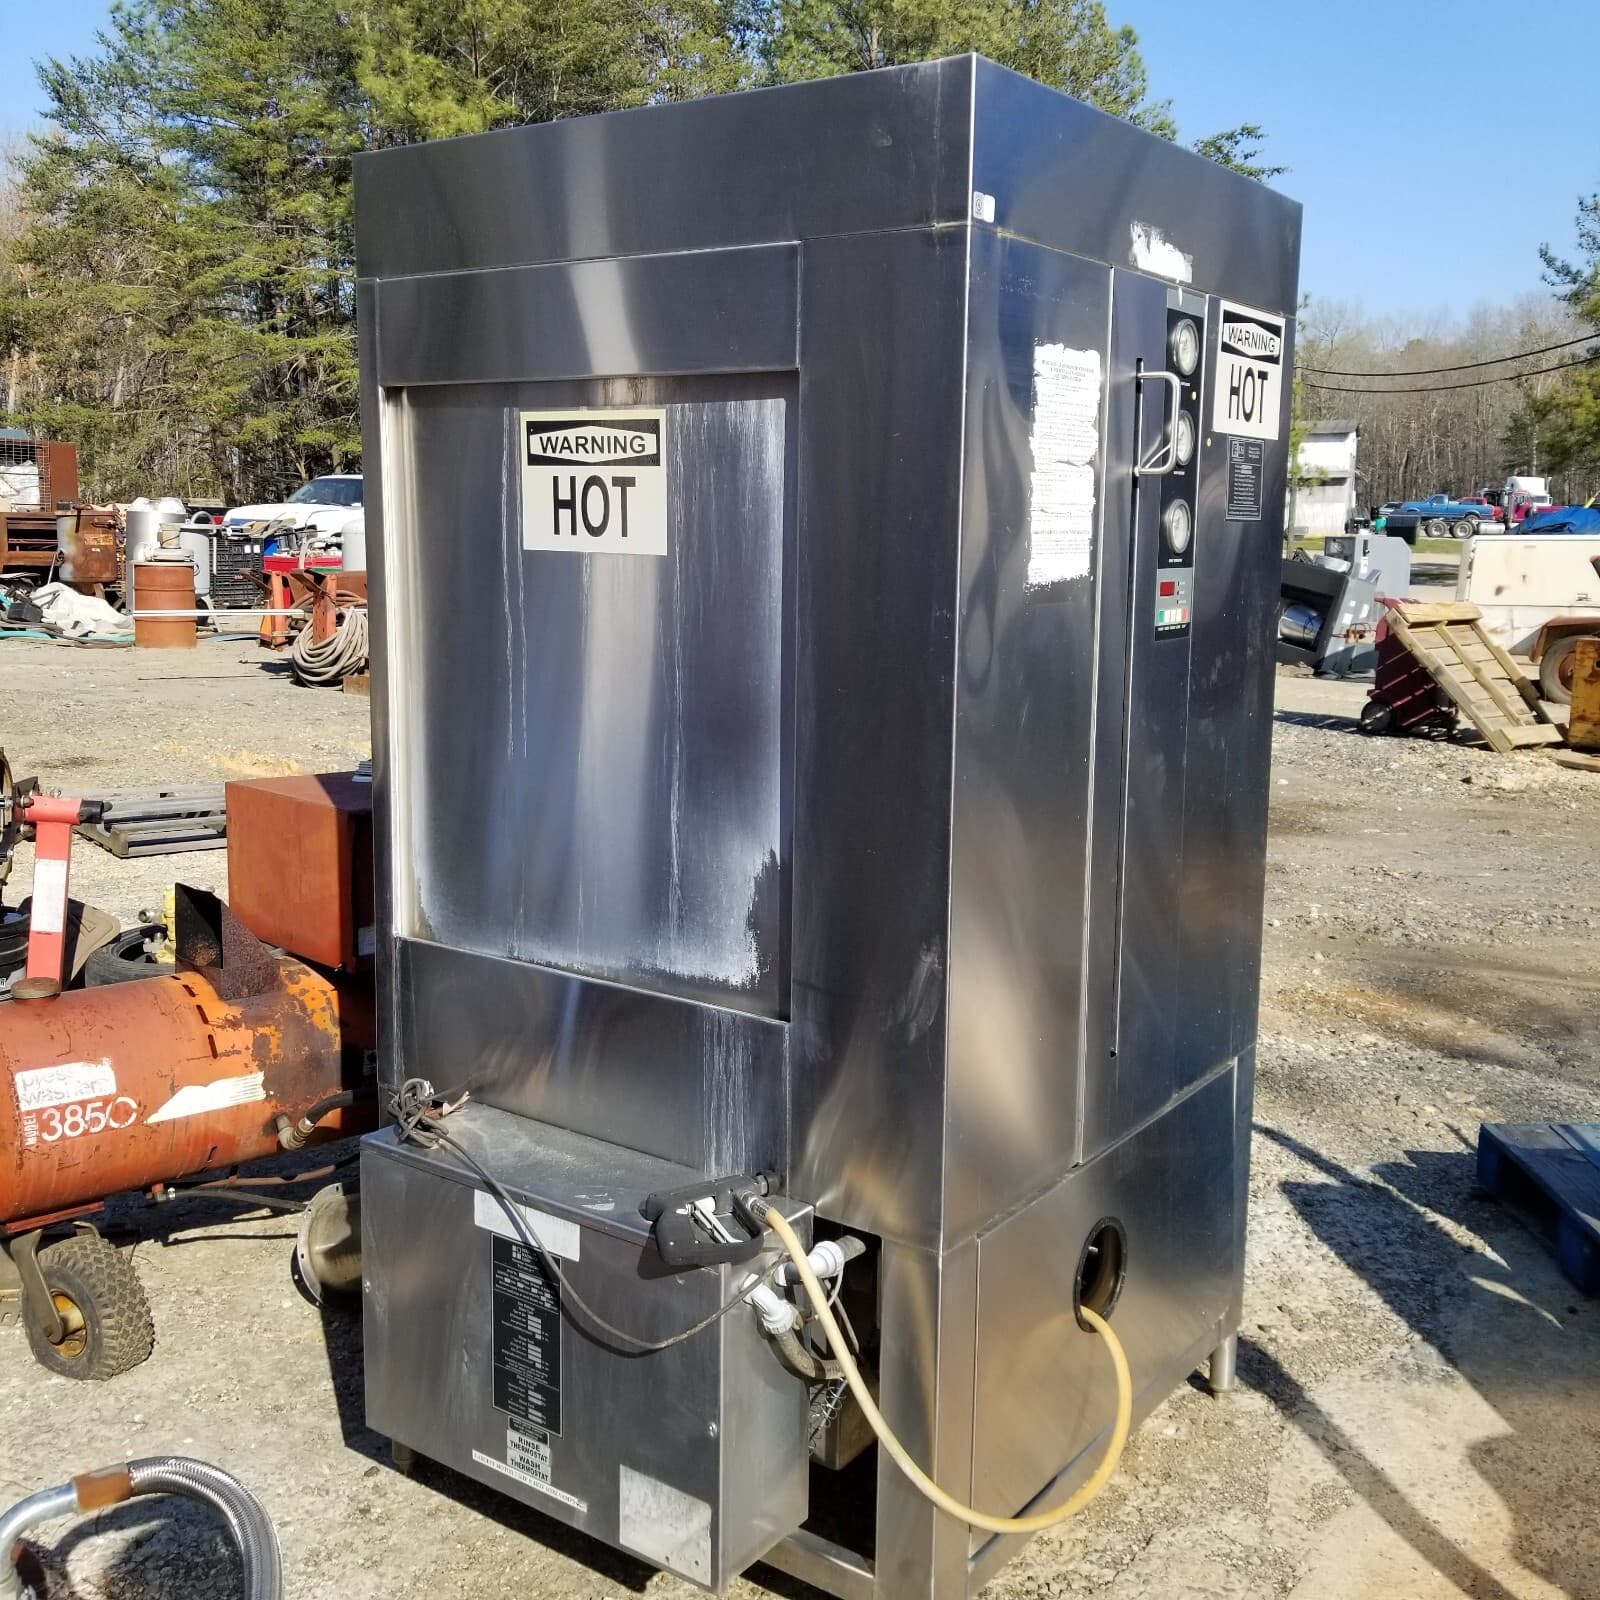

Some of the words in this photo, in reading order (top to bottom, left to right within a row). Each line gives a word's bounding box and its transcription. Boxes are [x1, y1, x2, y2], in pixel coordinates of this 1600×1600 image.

[1227, 325, 1276, 353] WARNING
[1228, 363, 1269, 424] HOT
[539, 435, 646, 454] WARNING
[552, 474, 637, 538] HOT
[23, 1112, 38, 1147] MODEL
[40, 1096, 138, 1142] 3850
[510, 1440, 548, 1463] THERMOSTAT
[518, 1436, 541, 1453] RINSE
[511, 1458, 549, 1481] THERMOSTAT
[519, 1454, 541, 1471] WASH
